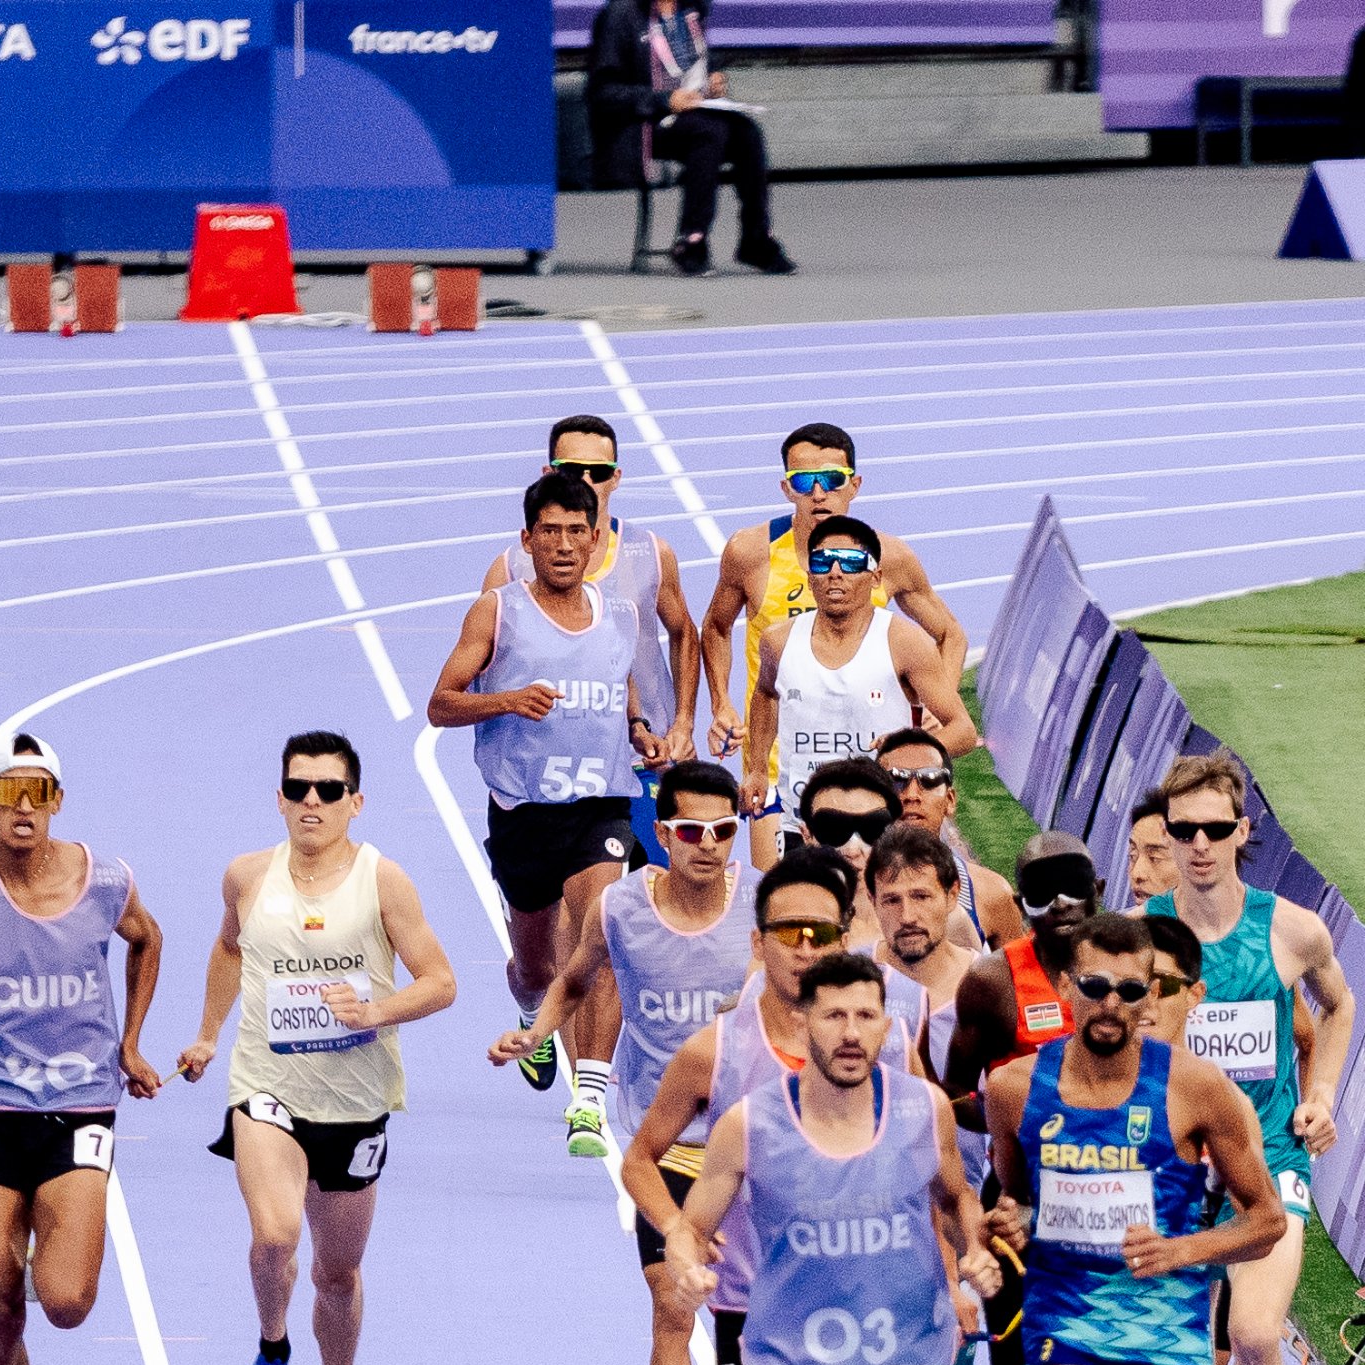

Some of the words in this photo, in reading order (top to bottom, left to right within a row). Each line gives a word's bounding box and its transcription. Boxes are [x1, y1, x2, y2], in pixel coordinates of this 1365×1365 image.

[795, 732, 875, 753] PERU
[539, 756, 607, 801] 55
[274, 954, 365, 974] ECUADOR
[271, 1006, 330, 1030] CASTRO
[263, 1101, 279, 1116] 7
[89, 1133, 103, 1157] 7
[366, 1145, 379, 1168] 7
[1040, 1143, 1146, 1170] BRASIL
[1055, 1181, 1124, 1194] TOYOTA
[1087, 1207, 1106, 1229] dos
[1108, 1203, 1149, 1230] SANTOS
[786, 1213, 911, 1257] GUIDE
